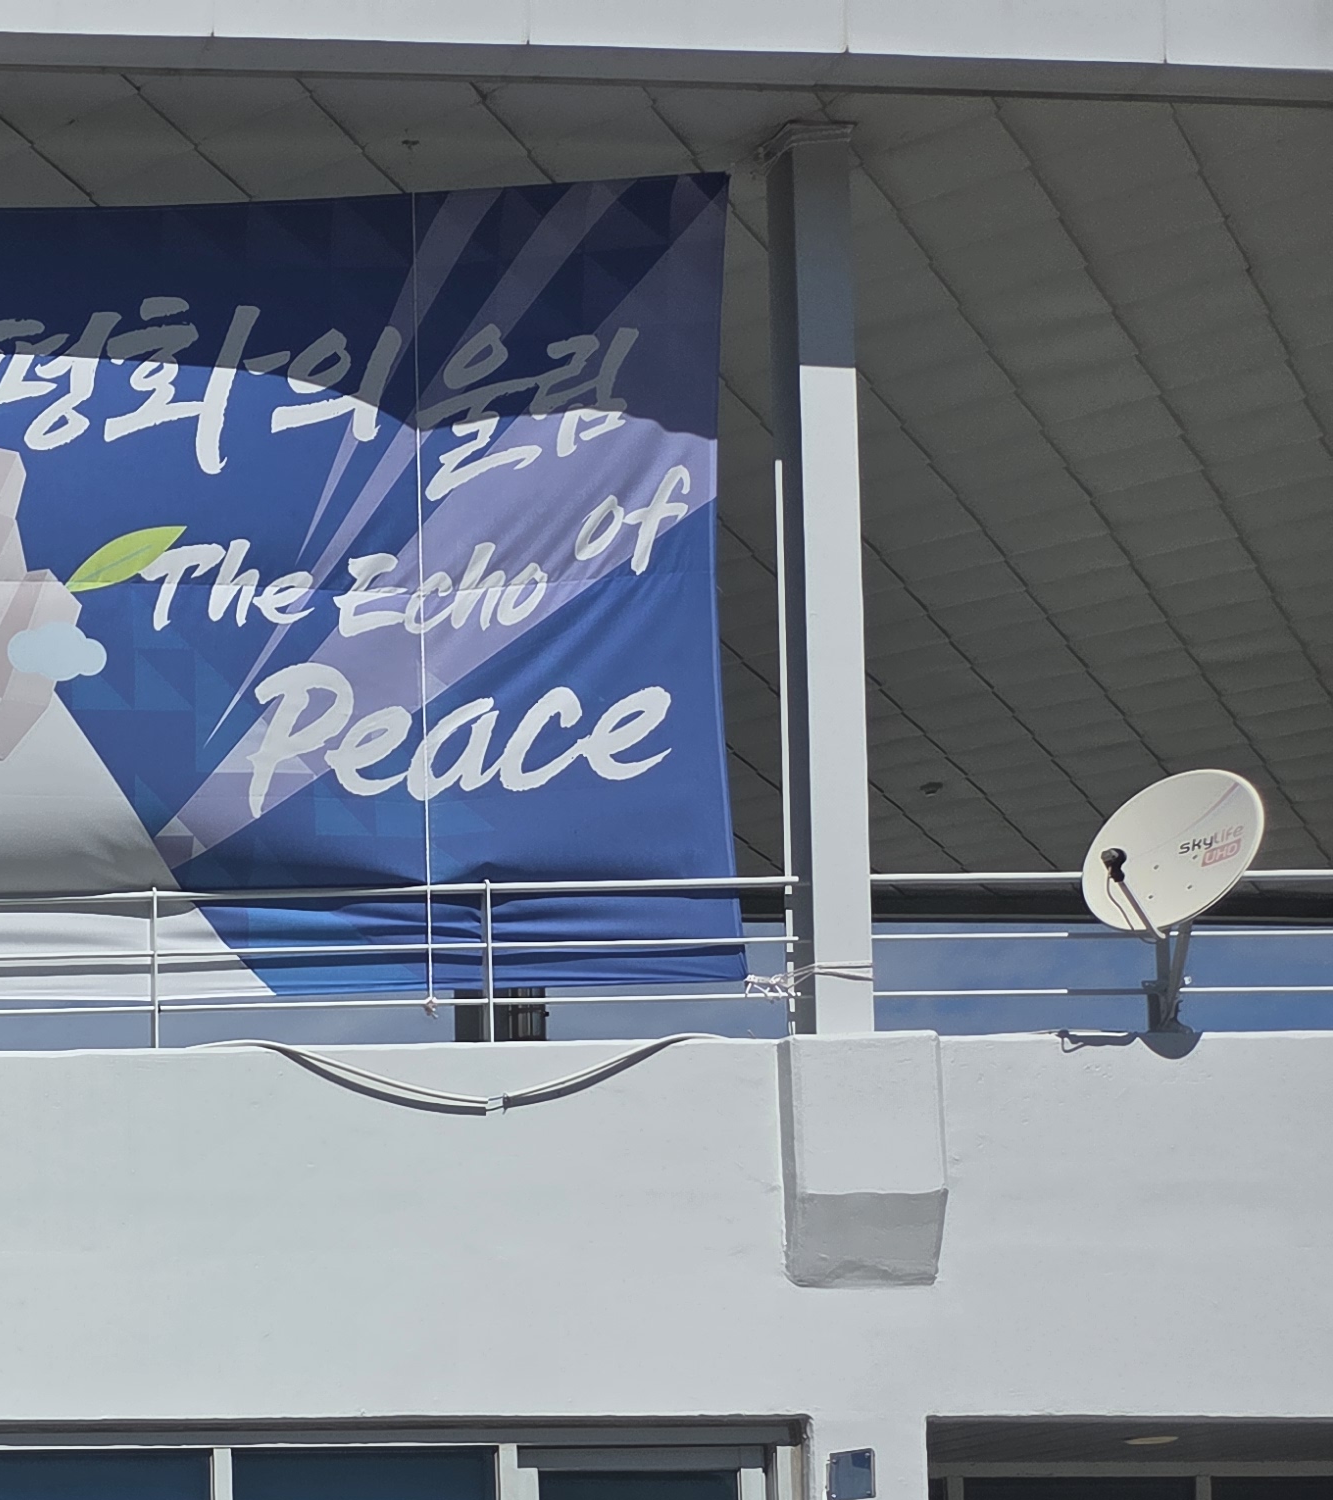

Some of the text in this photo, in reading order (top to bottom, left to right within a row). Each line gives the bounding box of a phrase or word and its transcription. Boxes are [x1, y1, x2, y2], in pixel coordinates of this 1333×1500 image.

[138, 465, 692, 636] The Echo of
[248, 660, 673, 820] Peace
